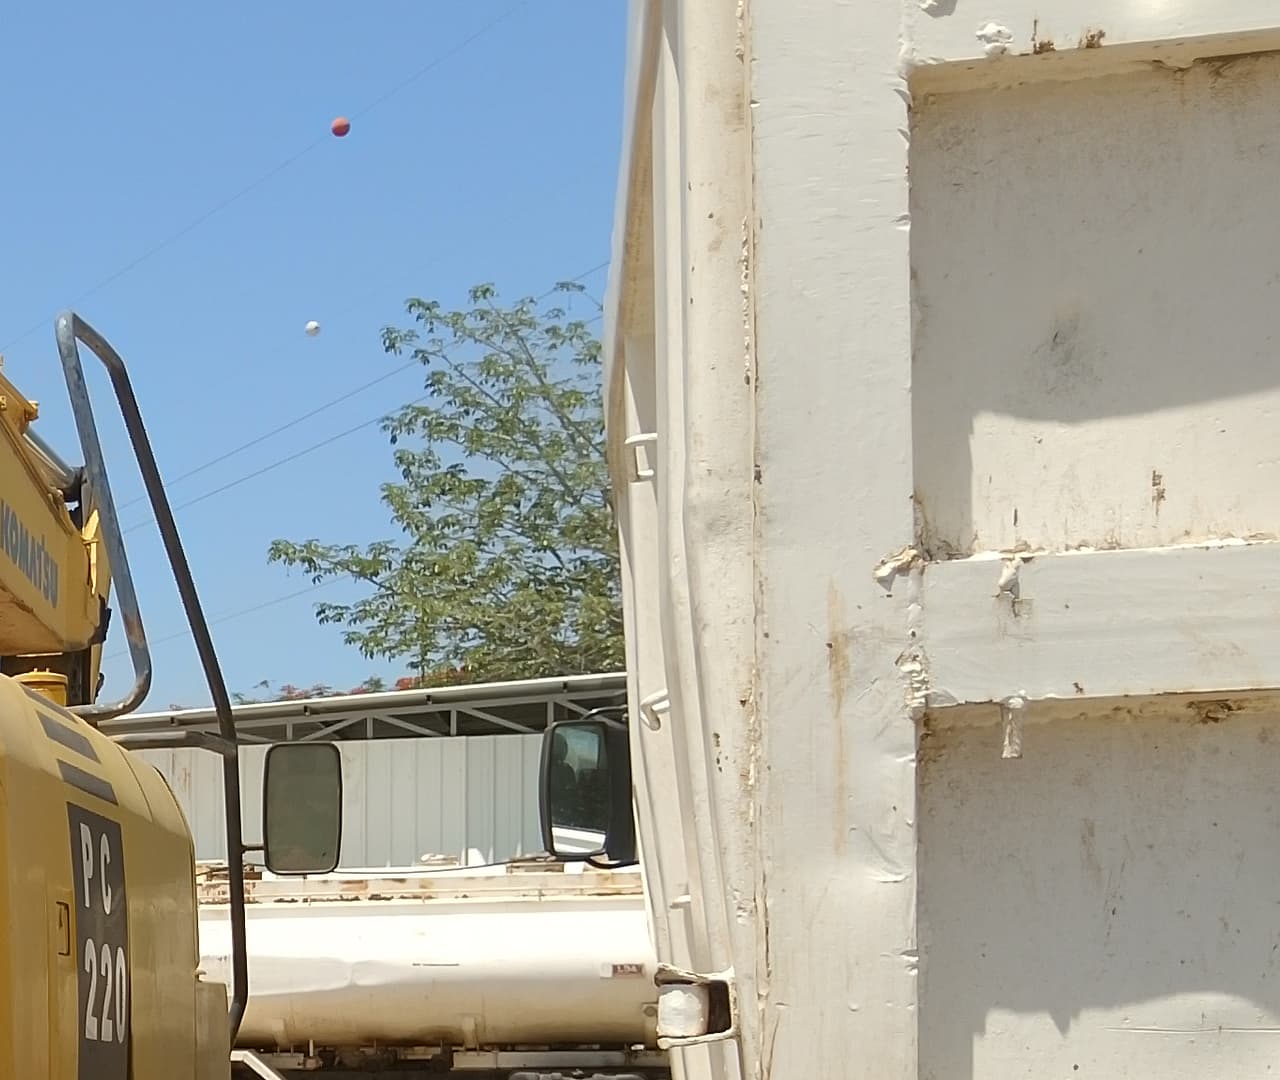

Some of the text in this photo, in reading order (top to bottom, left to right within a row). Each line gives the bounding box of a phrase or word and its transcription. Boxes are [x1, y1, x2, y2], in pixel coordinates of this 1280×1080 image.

[0, 499, 58, 608] KOMATSU
[79, 822, 112, 915] PC
[84, 938, 127, 1044] 220
